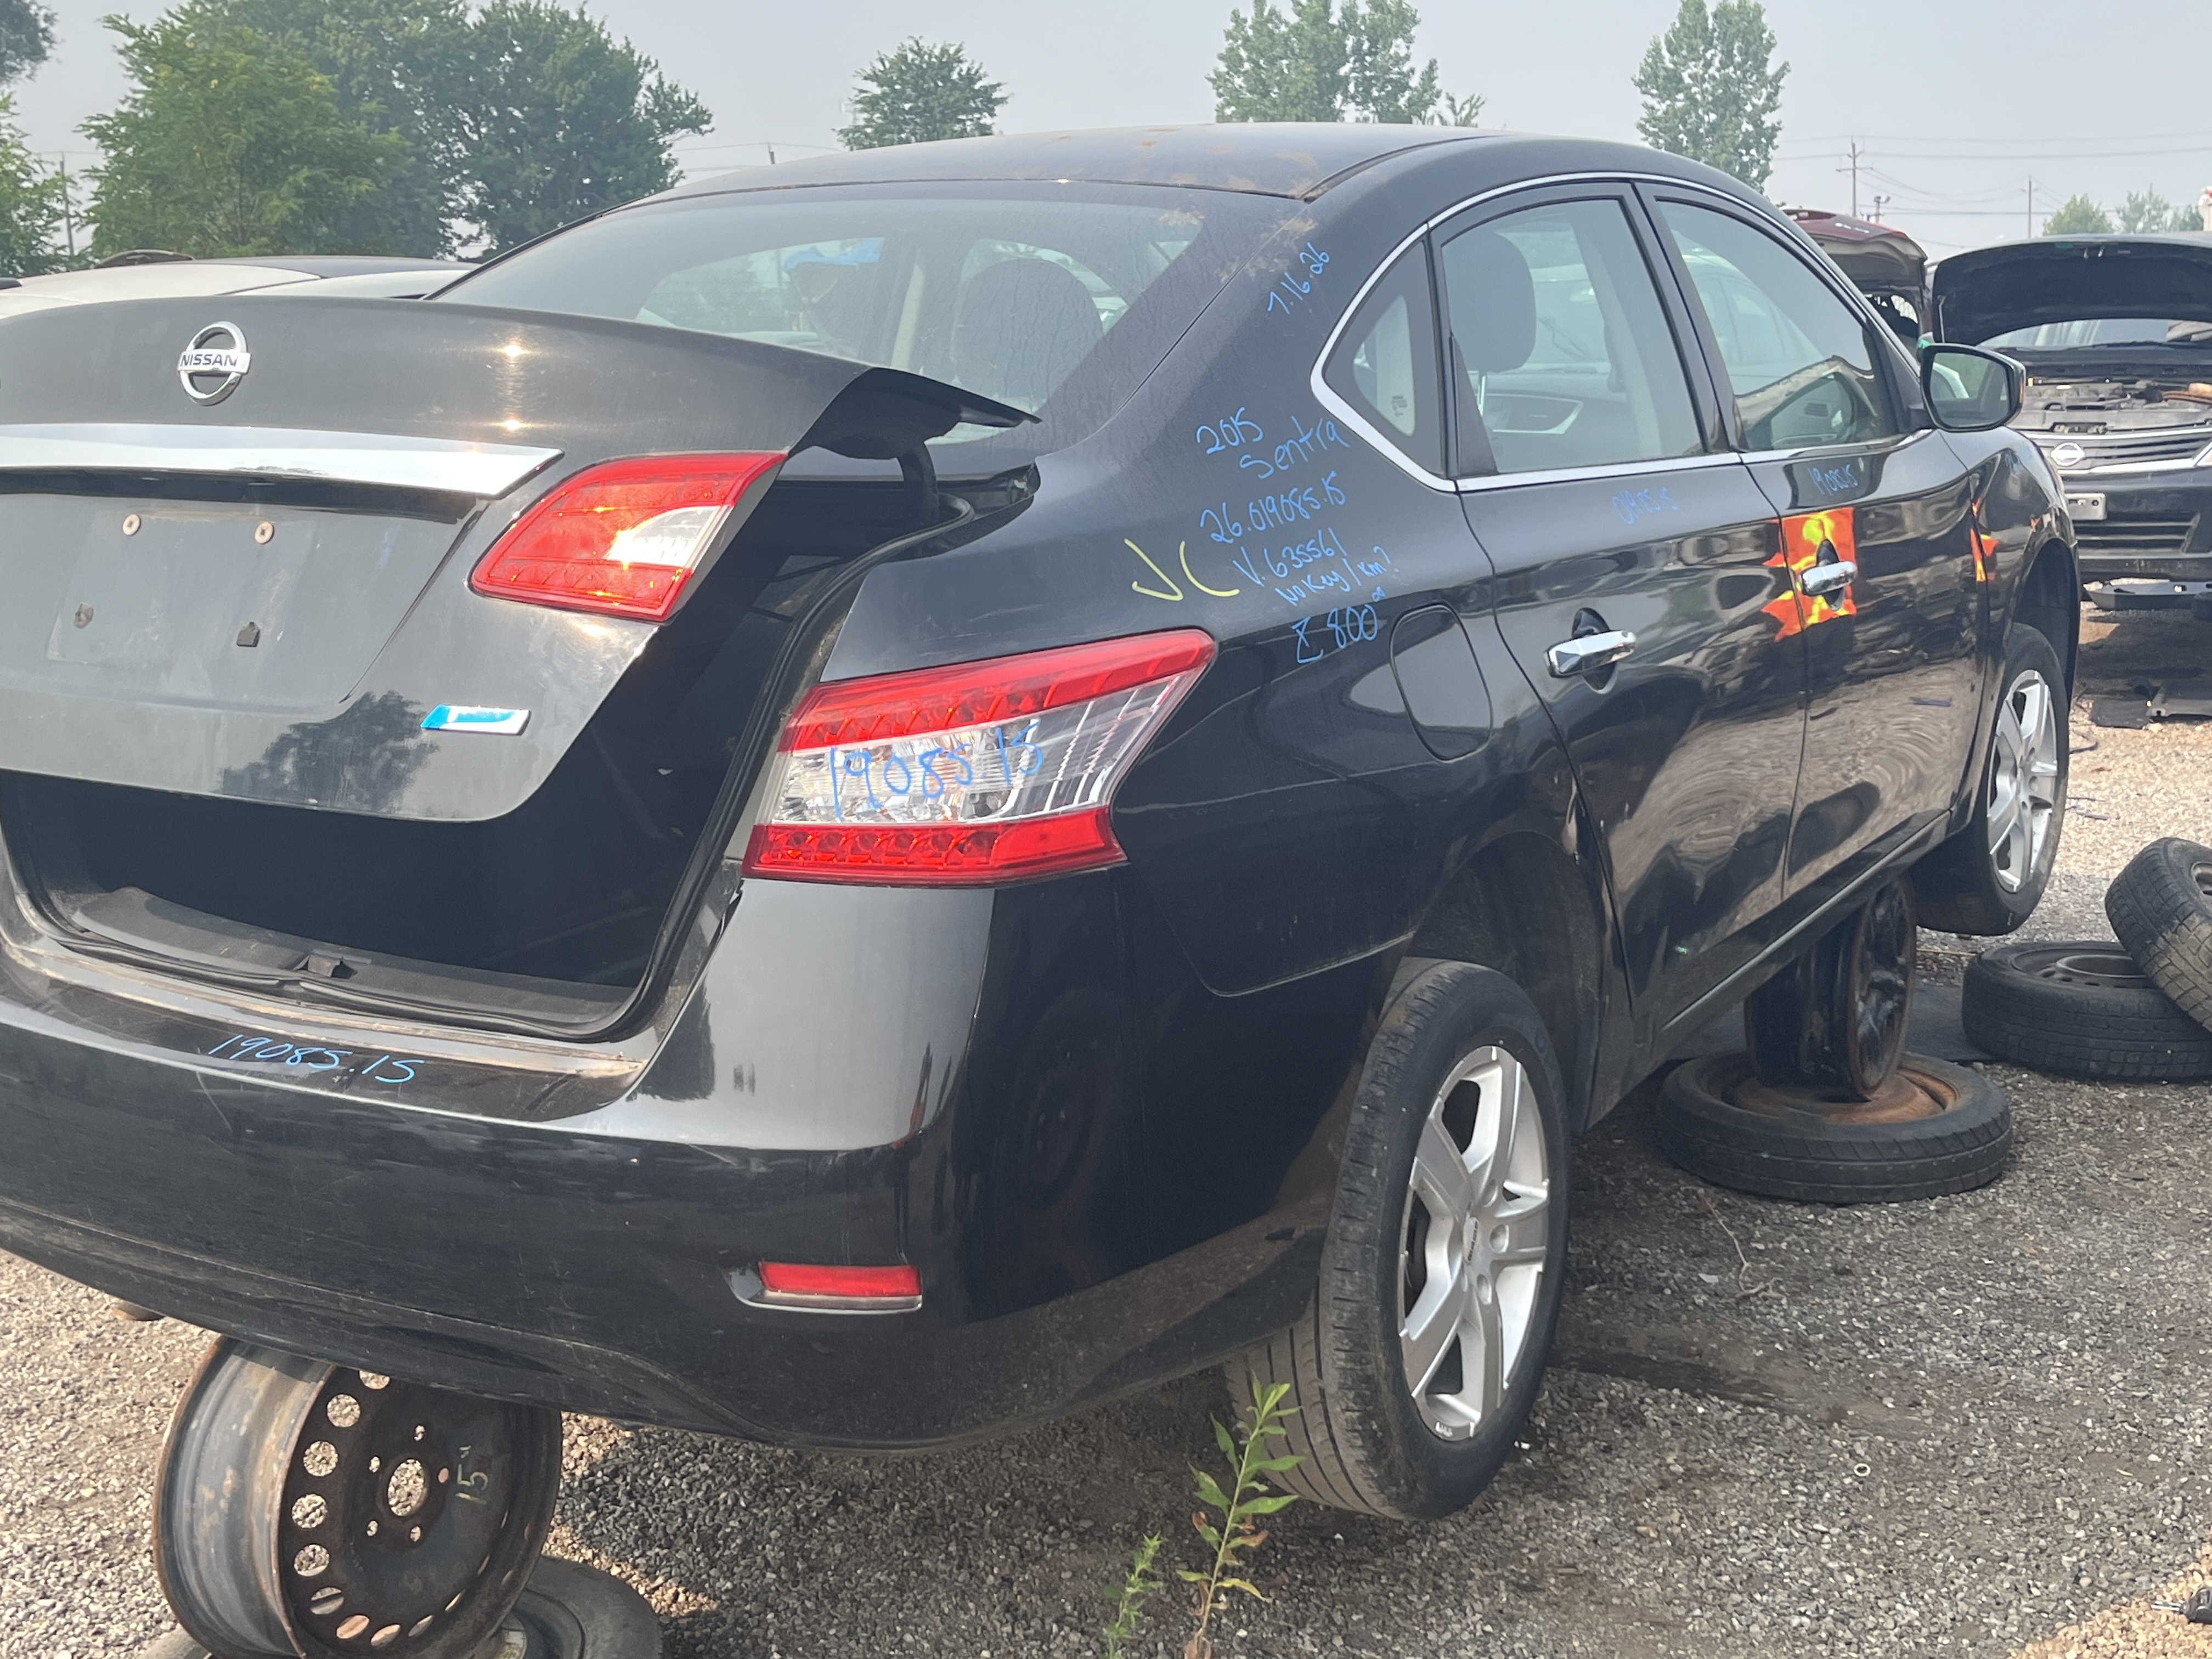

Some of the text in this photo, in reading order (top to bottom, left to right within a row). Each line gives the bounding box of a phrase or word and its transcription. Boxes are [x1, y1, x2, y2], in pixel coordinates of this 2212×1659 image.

[180, 353, 238, 367] NISSAN
[1196, 407, 1264, 455] 2015
[1239, 415, 1350, 479] Sentra
[207, 1034, 426, 1084] 19085.15
